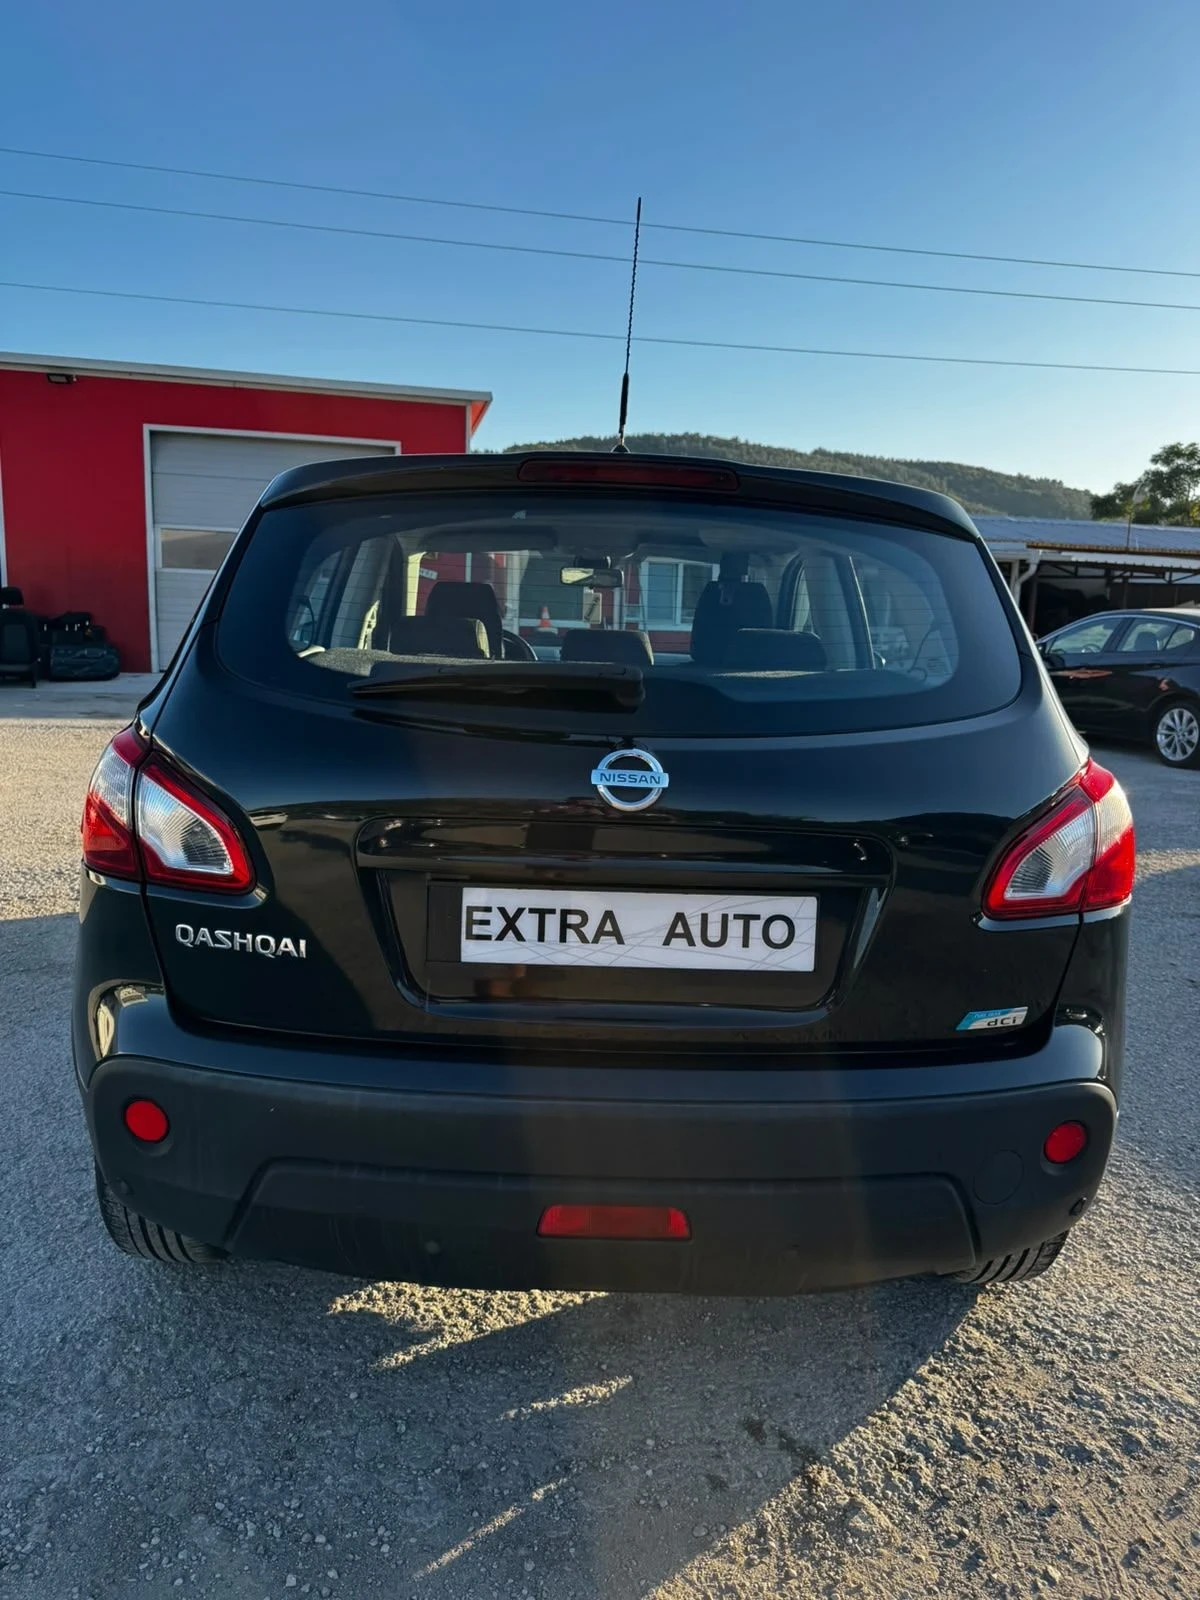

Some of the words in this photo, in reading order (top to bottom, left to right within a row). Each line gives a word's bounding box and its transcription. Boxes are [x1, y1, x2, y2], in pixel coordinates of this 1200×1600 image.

[600, 773, 660, 784] NISSAN
[175, 924, 306, 958] QASHQAI
[465, 905, 625, 945] EXTRA
[662, 912, 796, 949] AUTO
